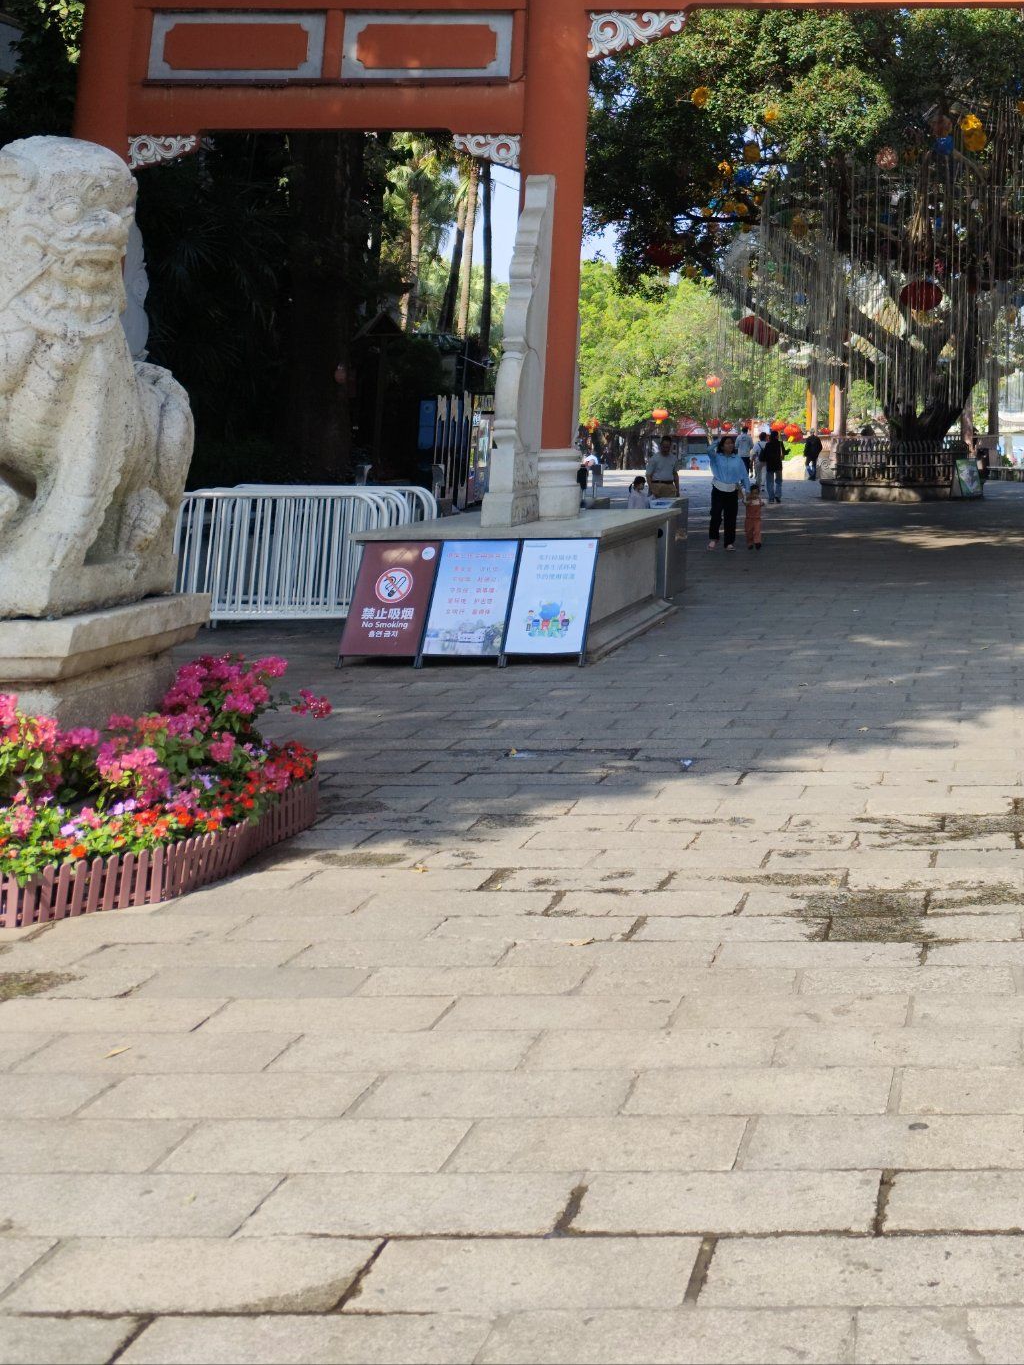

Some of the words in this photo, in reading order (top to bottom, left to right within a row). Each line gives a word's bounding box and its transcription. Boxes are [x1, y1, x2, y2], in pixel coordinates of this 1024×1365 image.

[361, 607, 414, 620] 禁止吸烟
[375, 621, 408, 630] Smoking
[383, 630, 398, 638] 금지
